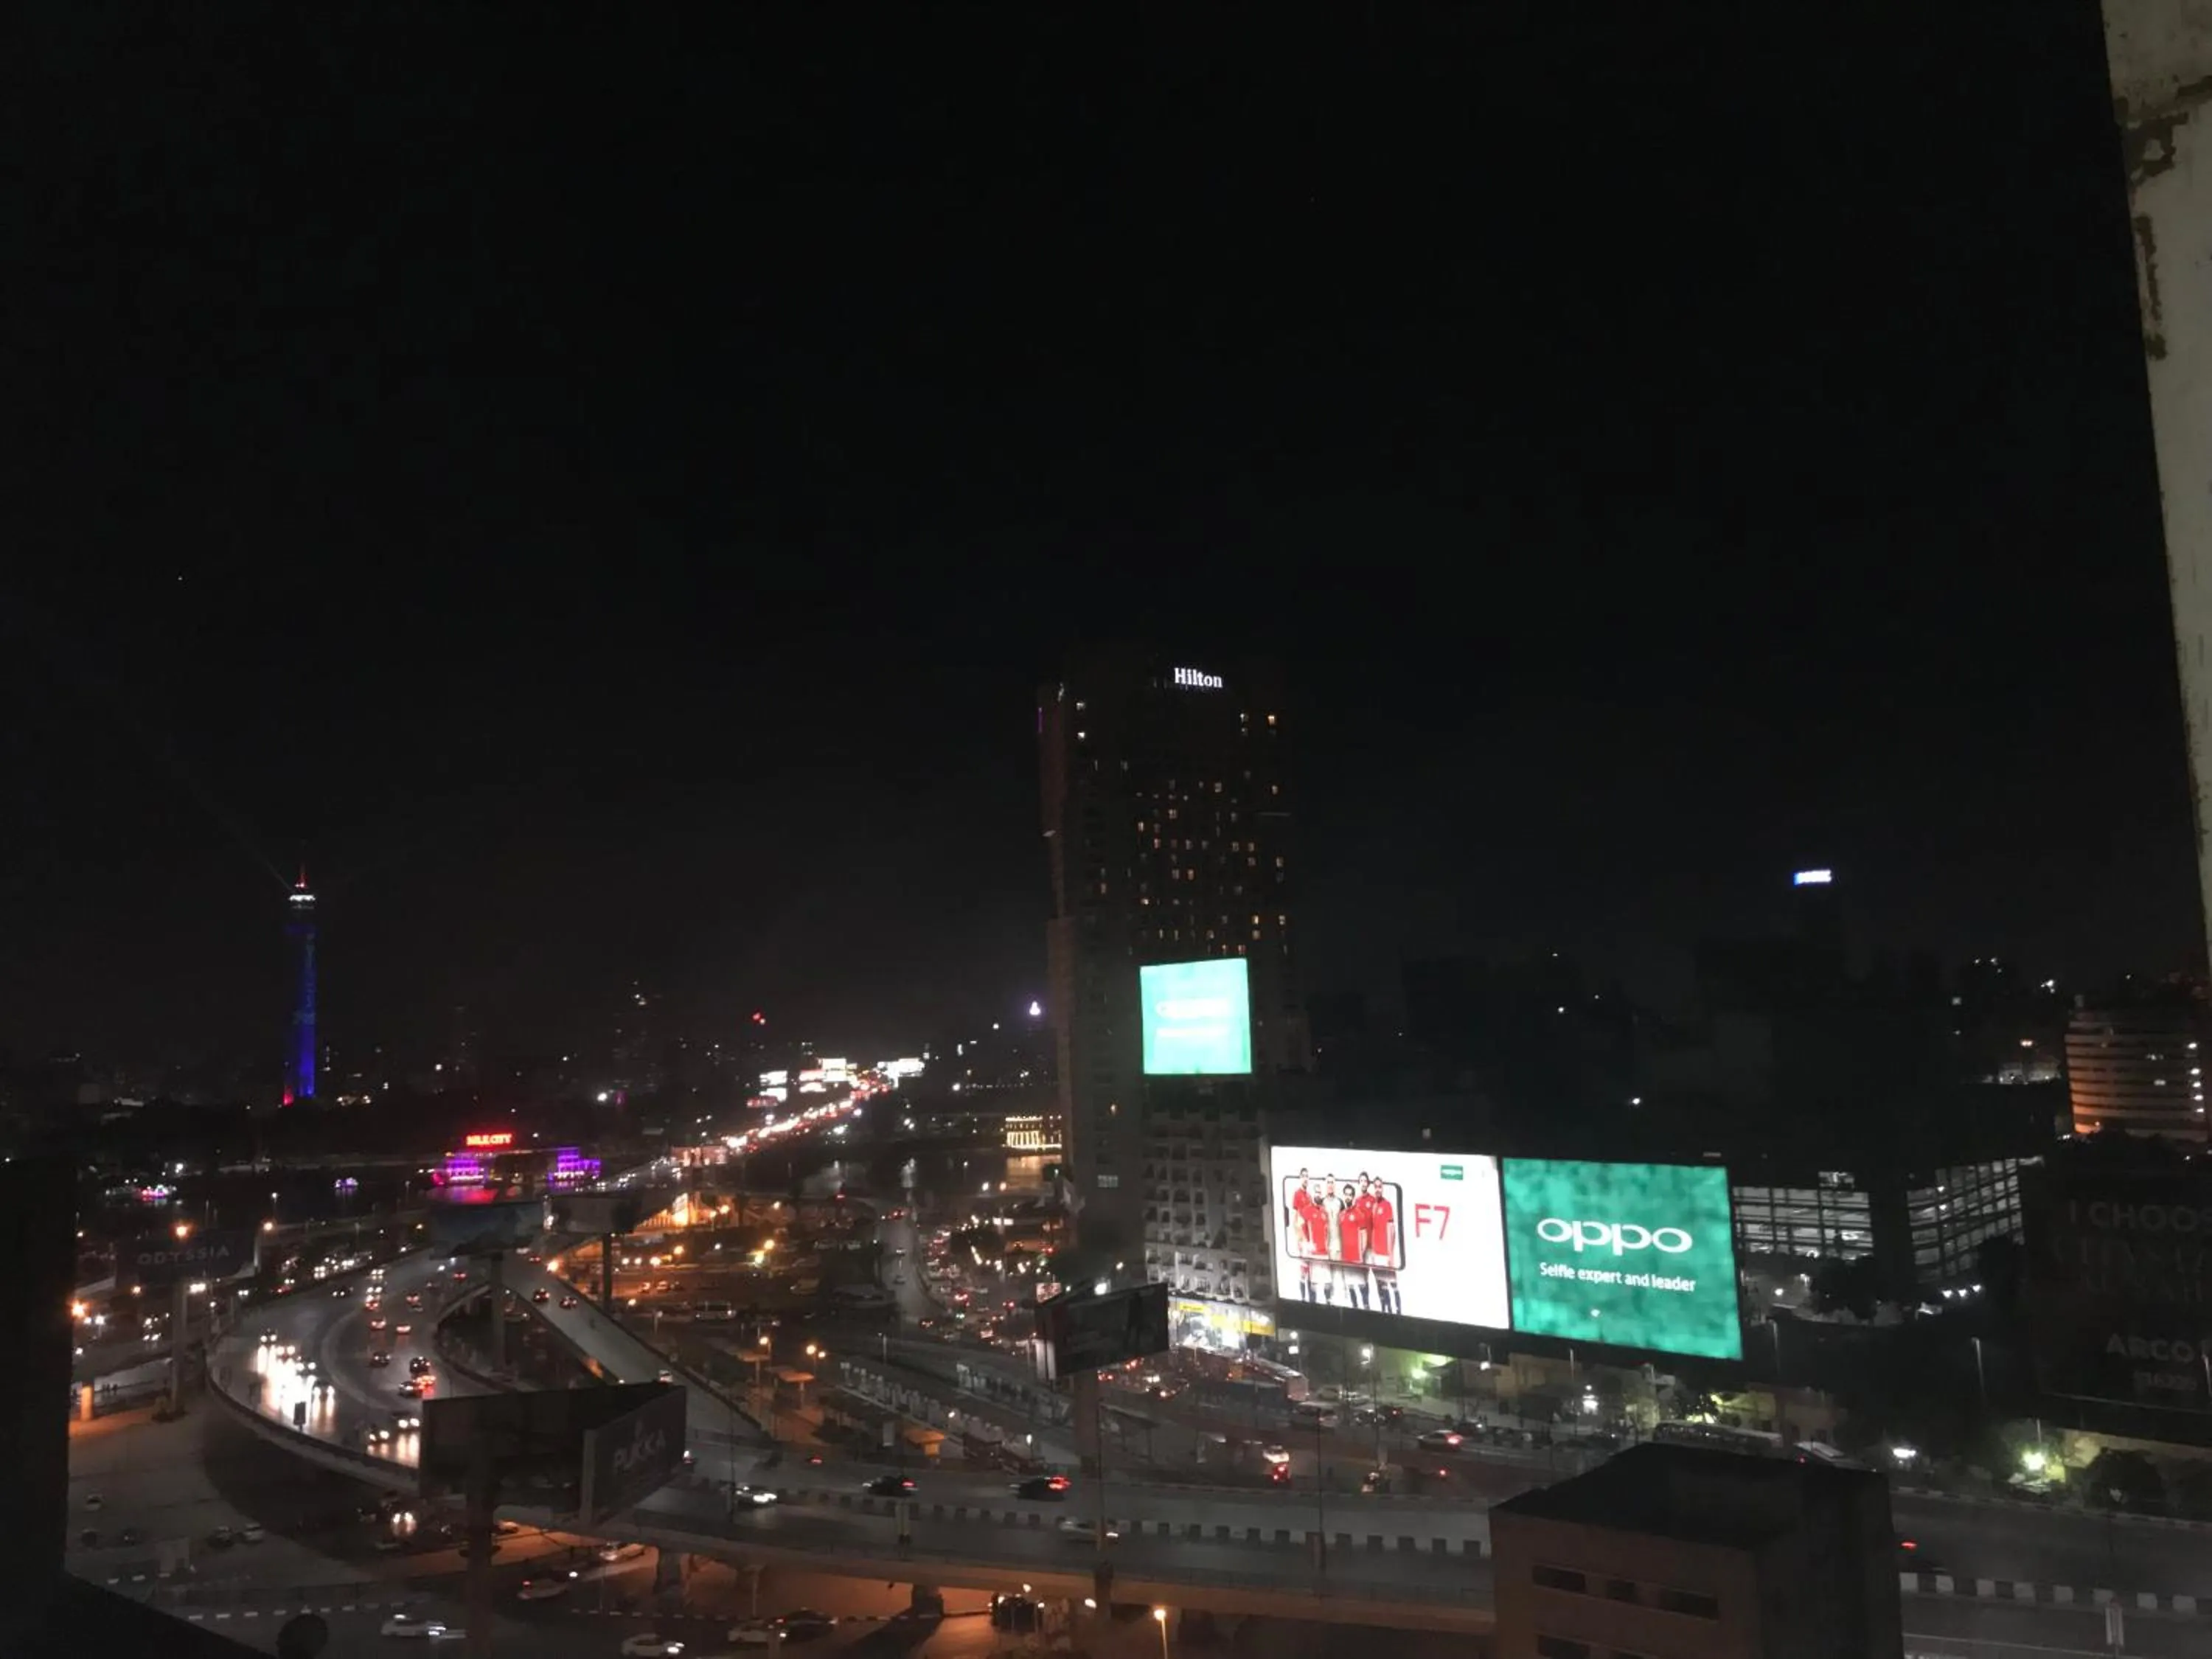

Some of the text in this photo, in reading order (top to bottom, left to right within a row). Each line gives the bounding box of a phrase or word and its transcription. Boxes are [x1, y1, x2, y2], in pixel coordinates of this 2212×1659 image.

[1175, 667, 1222, 688] Hilton
[1415, 1203, 1450, 1239] F7
[1540, 1262, 1696, 1293] Selfie expert and leader
